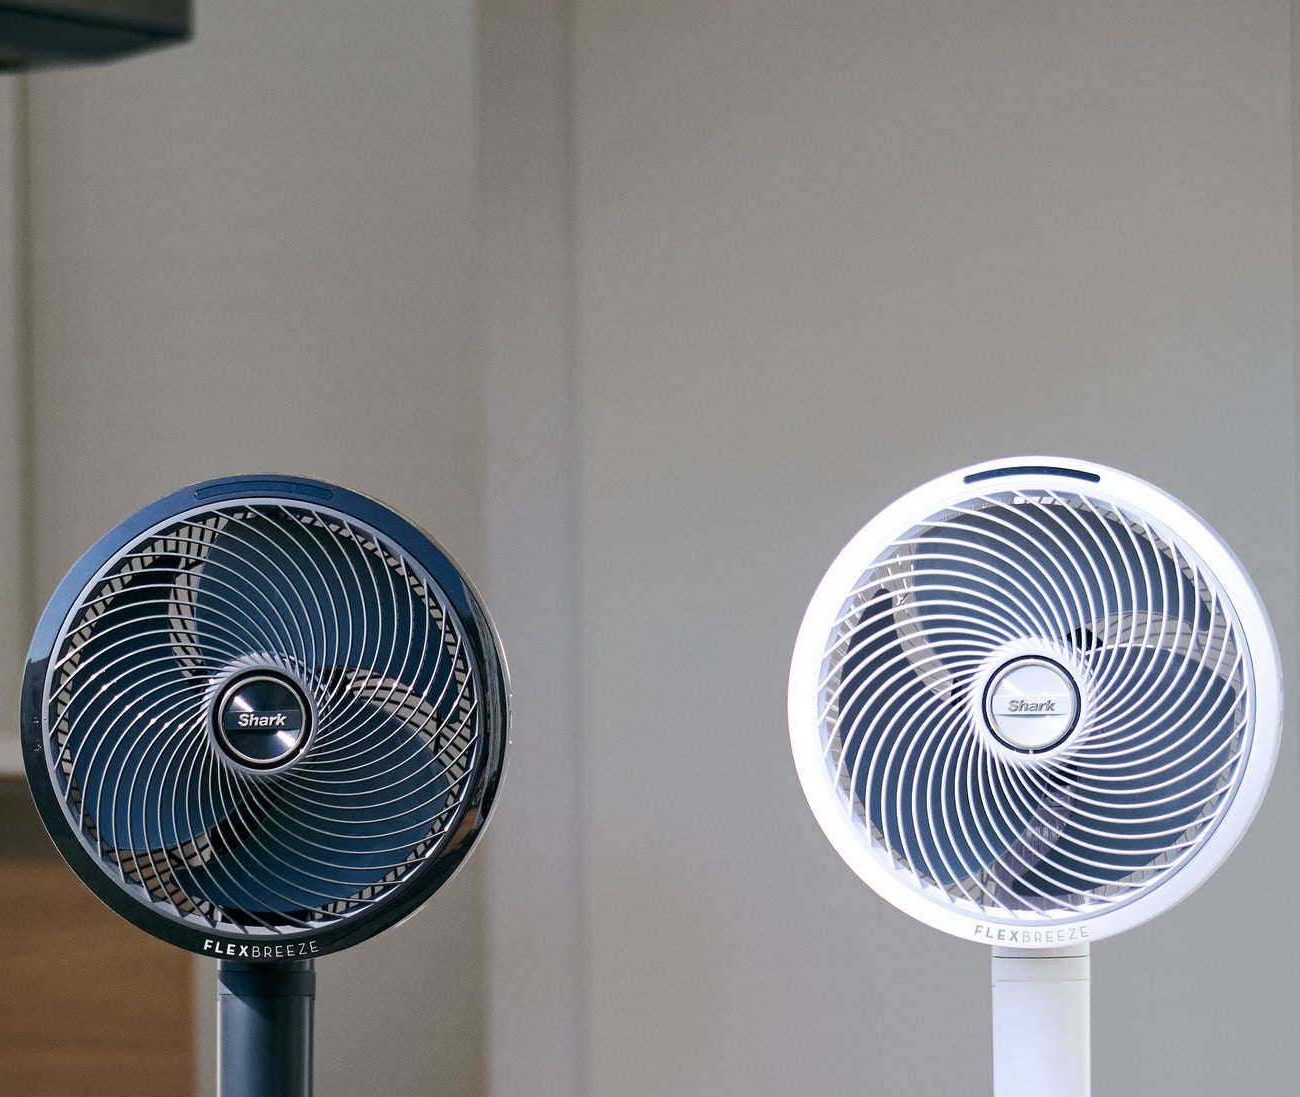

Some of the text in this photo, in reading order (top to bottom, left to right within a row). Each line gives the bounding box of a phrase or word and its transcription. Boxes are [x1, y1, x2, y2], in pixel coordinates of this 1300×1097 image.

[1007, 699, 1056, 712] Shark
[237, 713, 286, 727] Shark
[203, 939, 319, 958] FLEXBREEZE
